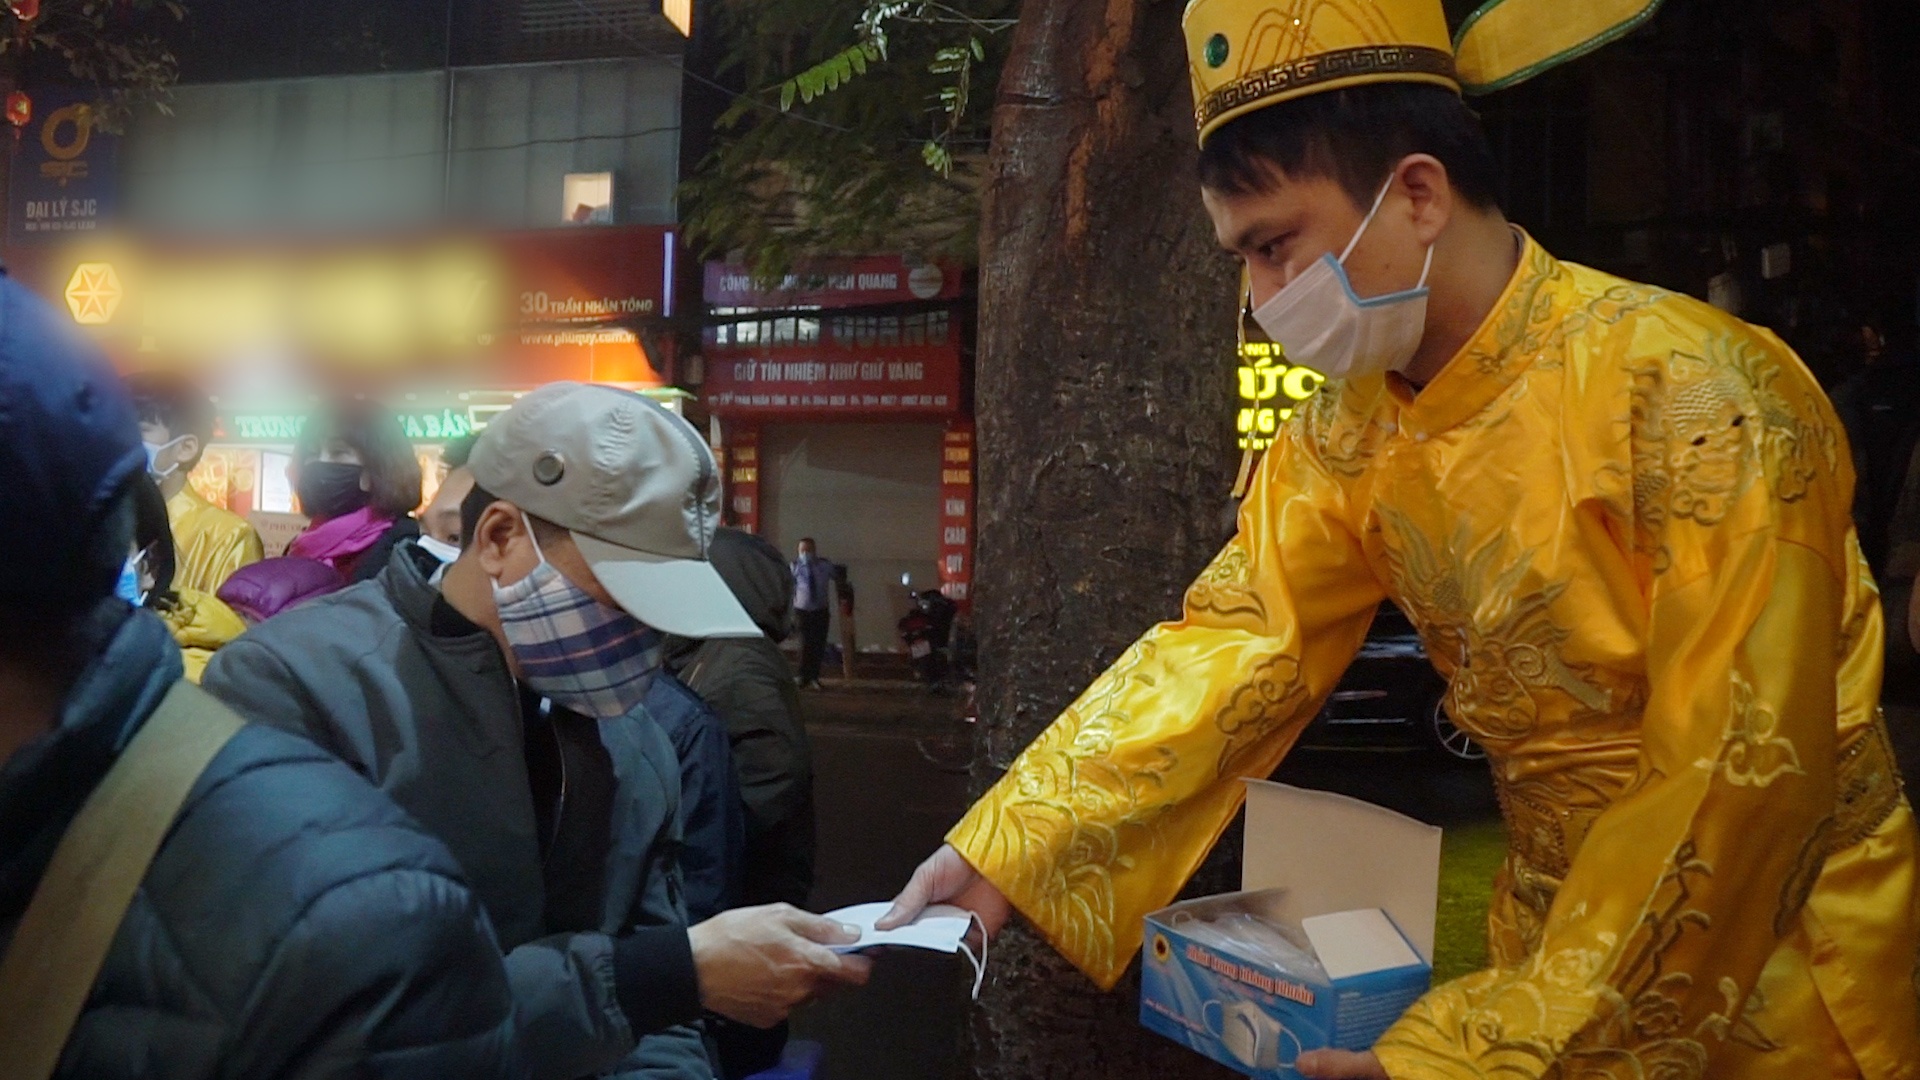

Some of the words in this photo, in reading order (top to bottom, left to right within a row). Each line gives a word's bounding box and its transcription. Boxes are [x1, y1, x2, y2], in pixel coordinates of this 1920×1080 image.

[71, 199, 97, 217] SJC
[858, 273, 898, 291] QUANG
[520, 291, 547, 314] 30
[761, 358, 782, 381] TÍN
